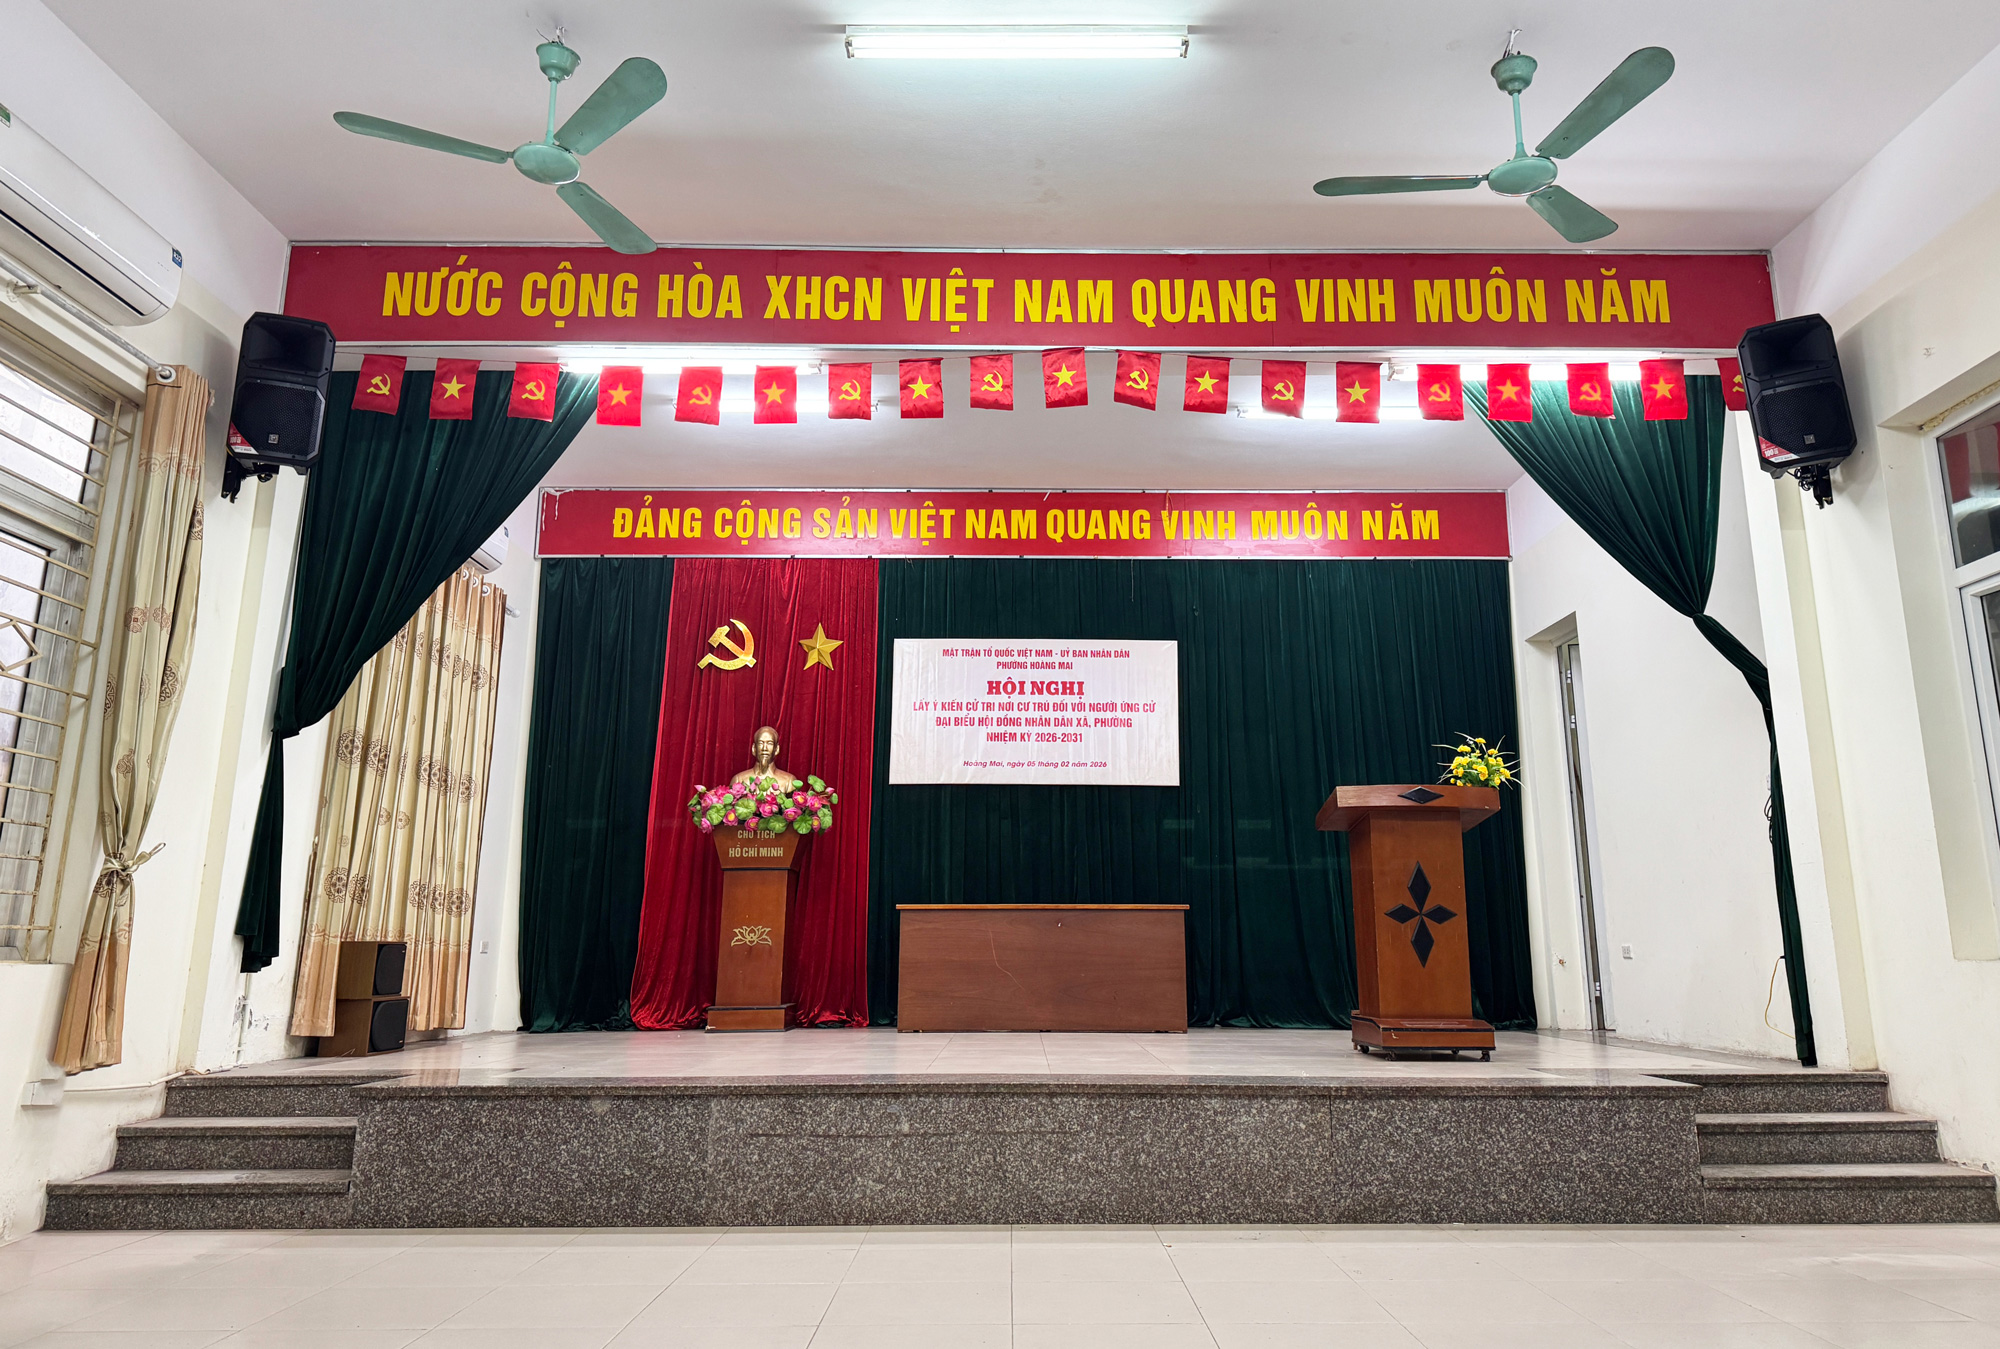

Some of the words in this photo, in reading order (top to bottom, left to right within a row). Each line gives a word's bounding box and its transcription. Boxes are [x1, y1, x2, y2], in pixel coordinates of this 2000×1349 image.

[382, 254, 503, 317] NƯỚC
[520, 261, 639, 328] CỘNG
[656, 261, 743, 319] HÒA
[763, 275, 883, 321] XHCN
[901, 267, 995, 333] VIỆT
[1014, 279, 1114, 324] NAM
[1131, 277, 1277, 328] QUANG
[1294, 278, 1396, 323] VINH
[1413, 266, 1547, 323] MUÔN
[1564, 267, 1671, 323] NĂM
[612, 494, 703, 539] ĐẢNG
[713, 499, 802, 546] CỘNG
[813, 496, 879, 539] SẢN
[888, 500, 956, 547] VIỆT
[965, 508, 1037, 541] NAM
[1046, 508, 1151, 543] QUANG
[1160, 509, 1237, 541] VINH
[1250, 501, 1349, 541] MUÔN
[1361, 503, 1440, 541] NĂM
[983, 645, 993, 657] TỔ
[994, 647, 1015, 658] QUỐC
[1017, 647, 1033, 659] VIỆT
[1034, 648, 1053, 658] NAM
[1060, 647, 1071, 658] UỶ
[1072, 649, 1088, 658] BAN
[1090, 648, 1112, 658] NHÂN
[1113, 649, 1130, 659] DÂN
[996, 660, 1028, 670] PHƯỜNG
[1029, 660, 1056, 670] HOÀNG
[1058, 661, 1073, 670] MAI
[986, 676, 1026, 699] HỘI
[1029, 680, 1085, 700] NGHỊ
[913, 698, 930, 712] LẤY
[932, 699, 939, 712] Ý
[941, 699, 963, 712] KIẾN
[965, 698, 979, 712] CỬ
[981, 702, 995, 712] TRI
[998, 701, 1014, 712] NƠI
[1017, 701, 1031, 712] CƯ
[1032, 700, 1049, 712] TRÚ
[1052, 699, 1068, 712] ĐỐI
[1071, 700, 1086, 712] VỚI
[1088, 700, 1117, 713] NGƯỜI
[1120, 701, 1139, 713] ỨNG
[1142, 700, 1157, 713] CỬ
[935, 716, 951, 728] ĐẠI
[953, 713, 975, 727] BIỂU
[977, 715, 994, 729] HỘI
[1024, 715, 1051, 727] NHÂN
[1053, 716, 1073, 728] DÂN
[1075, 716, 1092, 729] XÃ,
[1094, 716, 1133, 728] PHƯỜNG
[986, 730, 1017, 744] NHIỆM
[1019, 730, 1032, 742] KỲ
[1034, 732, 1083, 743] 2026-2031
[963, 760, 988, 769] Hoàng
[989, 760, 1005, 768] Mai,
[1006, 761, 1025, 769] ngày
[1026, 760, 1036, 768] 05
[1038, 760, 1059, 769] tháng
[1060, 760, 1070, 768] 02
[756, 830, 776, 841] TỊCH
[728, 842, 741, 858] HỒ
[742, 844, 758, 858] CHÍ
[759, 847, 784, 858] MINH
